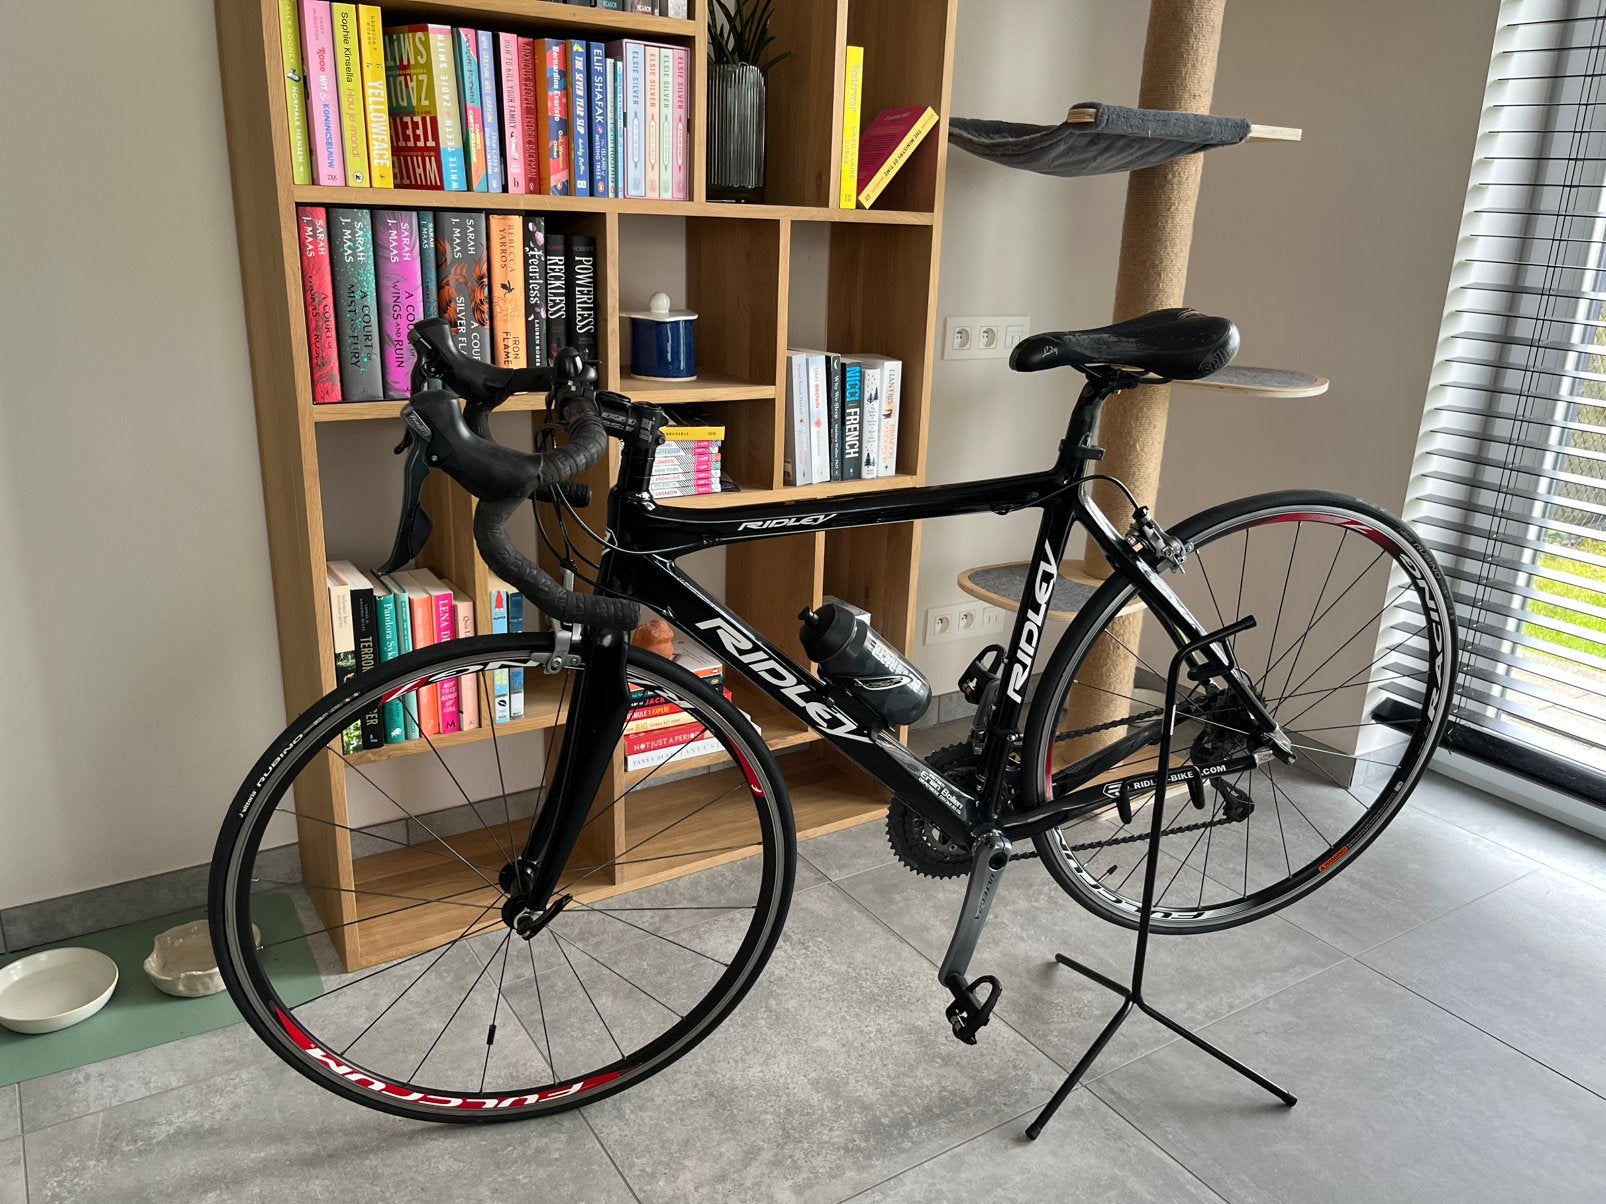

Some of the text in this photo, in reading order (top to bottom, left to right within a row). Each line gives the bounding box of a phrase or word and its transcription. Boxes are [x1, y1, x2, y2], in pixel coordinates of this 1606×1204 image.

[316, 47, 326, 72] ROOD
[341, 12, 354, 83] Sophie Kinsella
[320, 74, 328, 91] WIT
[504, 40, 517, 129] HOW TO KILL YOUR FAMILY
[521, 42, 534, 108] ANXIOUS PEOPLE
[552, 46, 560, 90] Bernardine
[594, 49, 604, 123] ELIF SHAFAK
[346, 88, 355, 109] Hou
[437, 34, 459, 190] WHITE TEETH ZADIE SMITH
[575, 56, 585, 134] THE SEVEN YEAR SLIP
[292, 86, 304, 162] NORMALE MENSEN
[347, 112, 357, 122] je
[368, 80, 390, 168] YELLOWFACE
[322, 104, 335, 169] KONINGSBLAUW
[526, 115, 537, 178] FREDRIK BACKMAN
[897, 138, 915, 161] MINISTRY
[883, 165, 895, 177] TIME
[304, 226, 315, 257] MAAS
[315, 220, 326, 255] SARAH
[343, 230, 354, 263] MAAS
[354, 222, 366, 260] SARAH
[389, 231, 399, 263] MAAS
[400, 222, 411, 261] SARAH
[452, 228, 462, 258] MAAS
[466, 218, 476, 254] SARAH
[499, 228, 508, 269] YARROS
[507, 224, 516, 272] REBECCA
[525, 241, 545, 304] Fearless
[546, 256, 566, 319] RECKLESS
[320, 292, 328, 300] A
[347, 284, 357, 316] MIST
[360, 290, 368, 300] A
[390, 280, 402, 320] WINGS
[404, 290, 414, 300] A
[575, 256, 594, 333] POWERLESS
[322, 305, 332, 338] COURT
[362, 305, 374, 350] COURT
[456, 296, 466, 334] SILVER
[350, 335, 361, 369] FURY
[395, 340, 405, 368] RUIN
[470, 320, 481, 360] A COUR
[503, 331, 512, 366] FLAME
[512, 336, 520, 360] IRON
[846, 366, 860, 458] NICCI FRENCH
[738, 514, 838, 531] RIDLEY
[1414, 542, 1441, 580] RUBINO
[384, 603, 397, 660] Pandora Syk
[438, 600, 448, 628] LENA
[1007, 539, 1058, 704] RIDLEY
[1399, 554, 1444, 723] RACING
[441, 692, 457, 700] KIND
[695, 617, 876, 743] RIDLEY
[644, 697, 666, 706] JACK
[652, 706, 670, 716] EXPERT
[634, 741, 650, 752] NOT
[650, 738, 667, 750] JUST
[668, 736, 674, 744] A
[636, 722, 648, 730] BIG
[256, 734, 304, 788] RUBINO
[920, 770, 940, 790] Erwin
[941, 788, 963, 810] Bollen
[305, 1047, 584, 1108] FULCRUM
